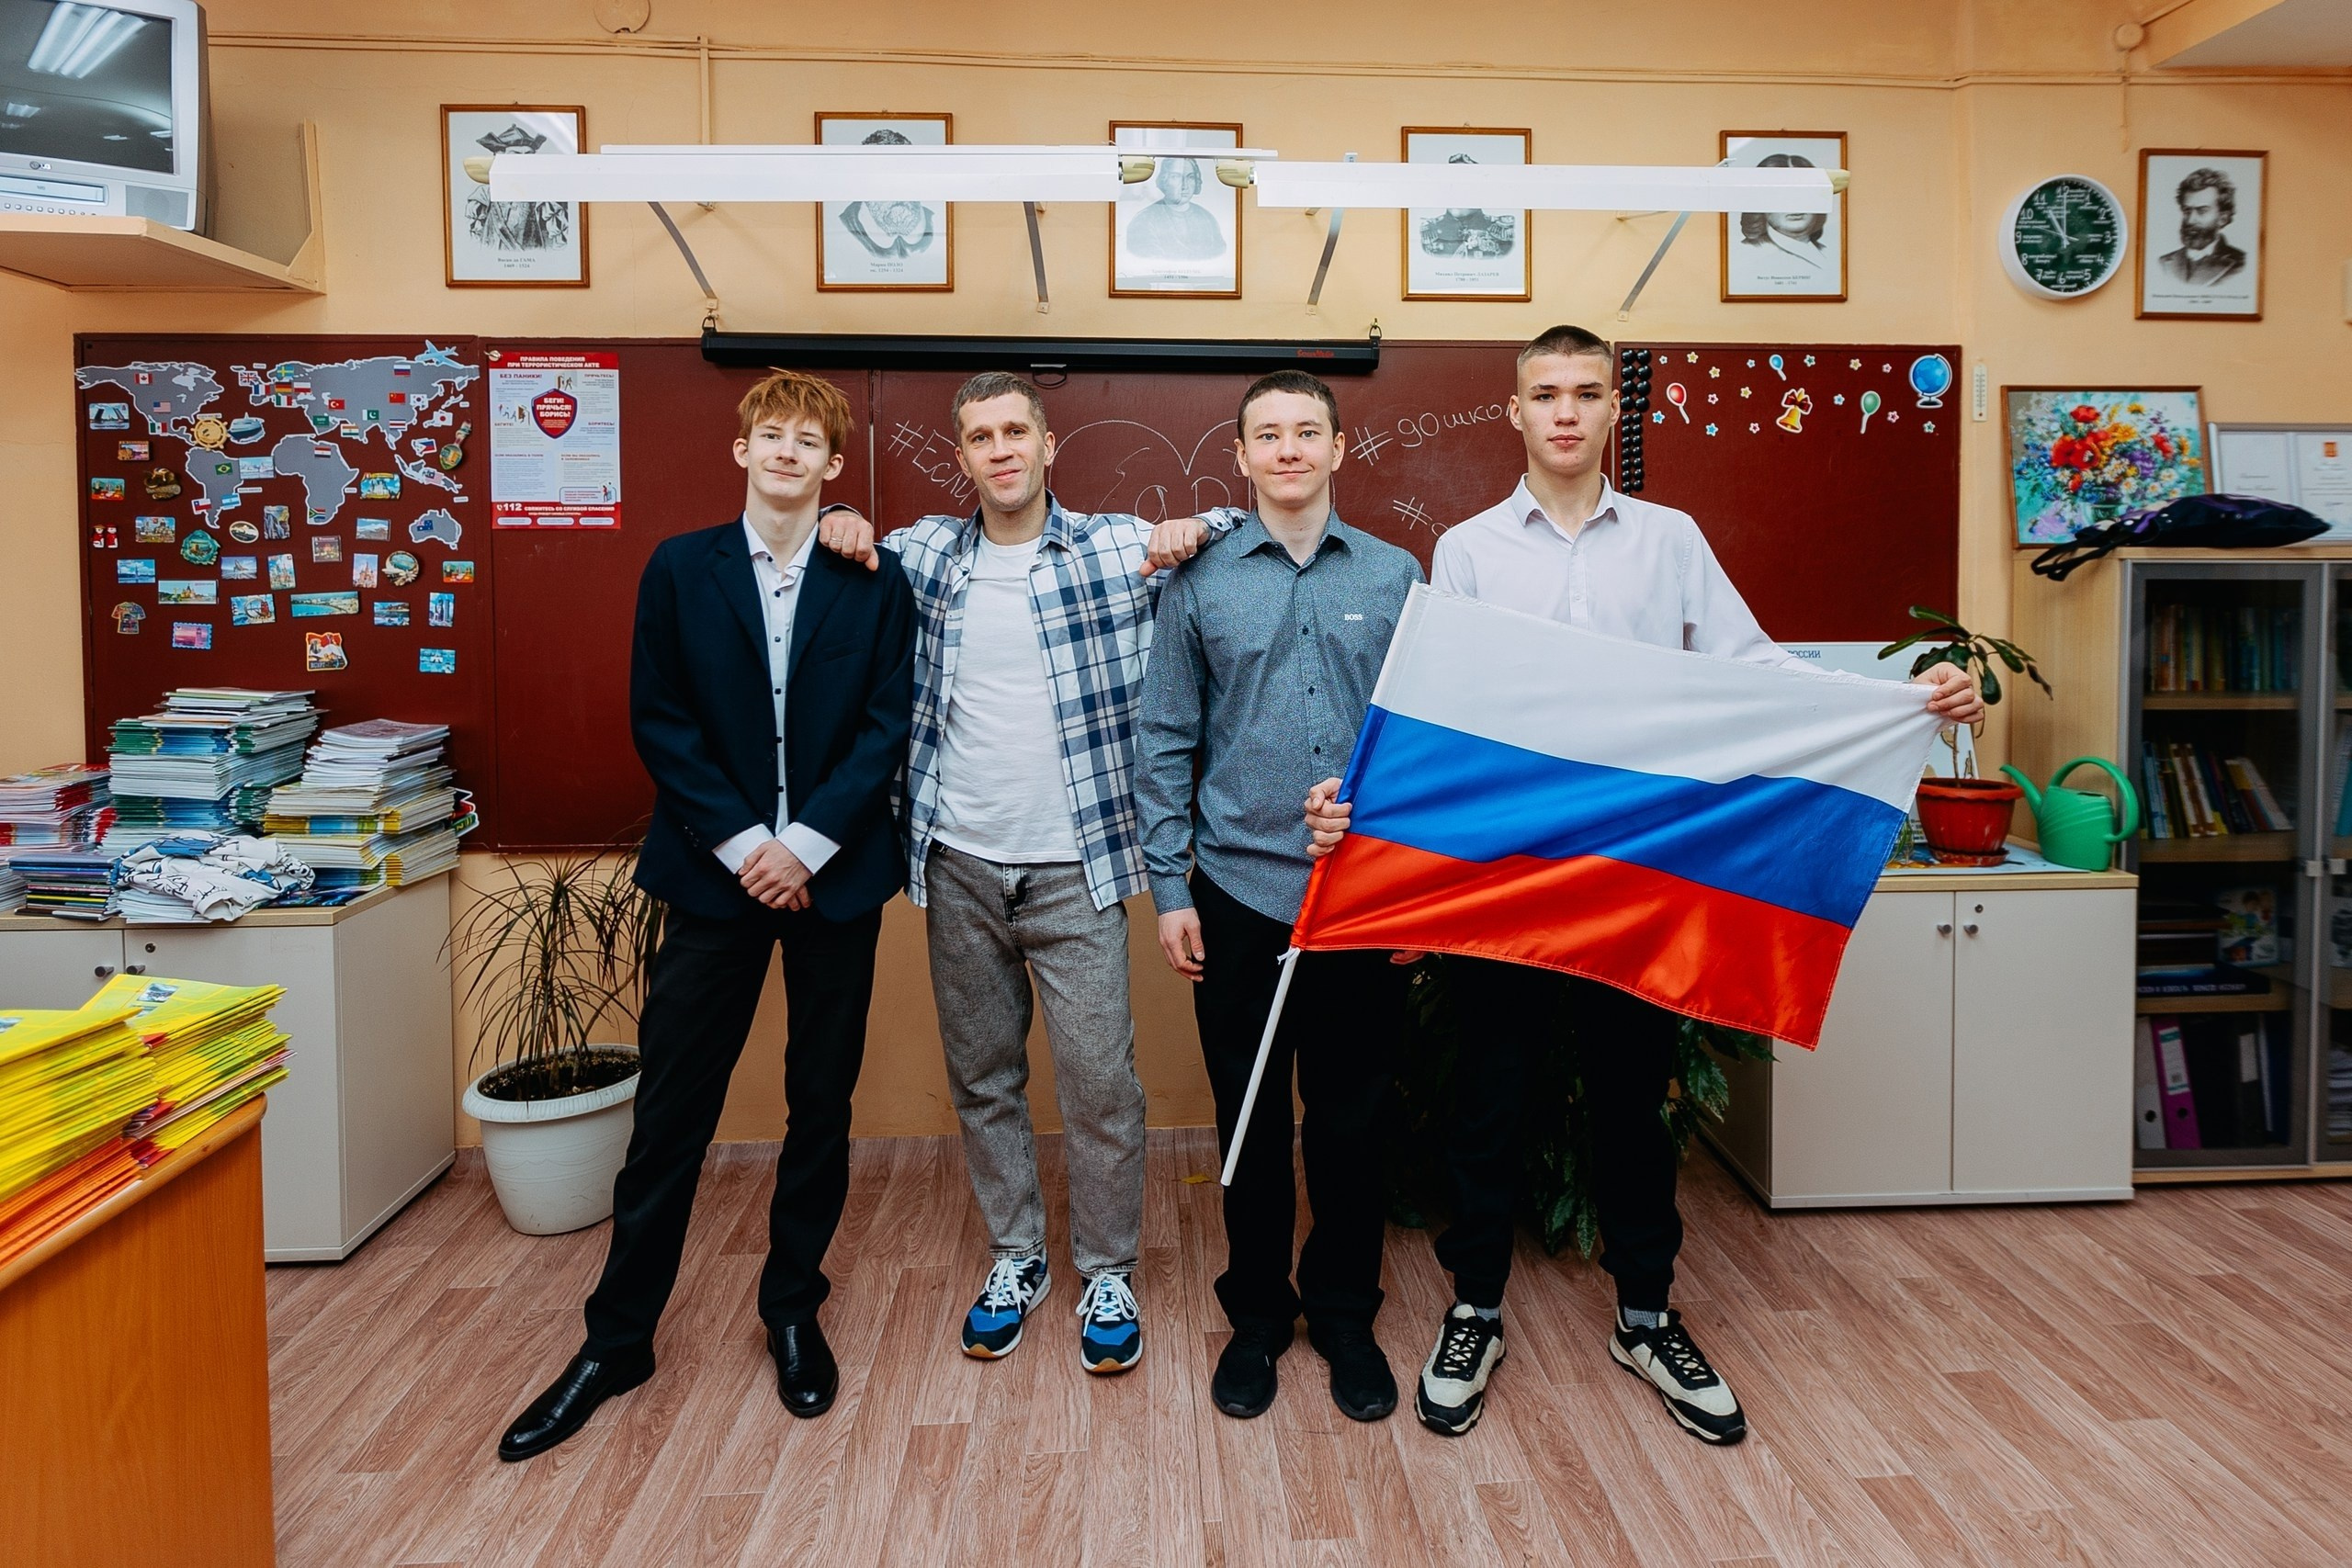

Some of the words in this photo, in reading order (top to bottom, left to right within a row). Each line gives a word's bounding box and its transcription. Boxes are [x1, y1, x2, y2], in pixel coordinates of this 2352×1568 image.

[2020, 208, 2034, 220] 10
[2015, 231, 2022, 243] 9
[2104, 231, 2112, 243] 3
[2020, 254, 2029, 265] 8
[2057, 272, 2066, 284] 6
[2084, 268, 2092, 281] 5
[503, 502, 522, 512] 112
